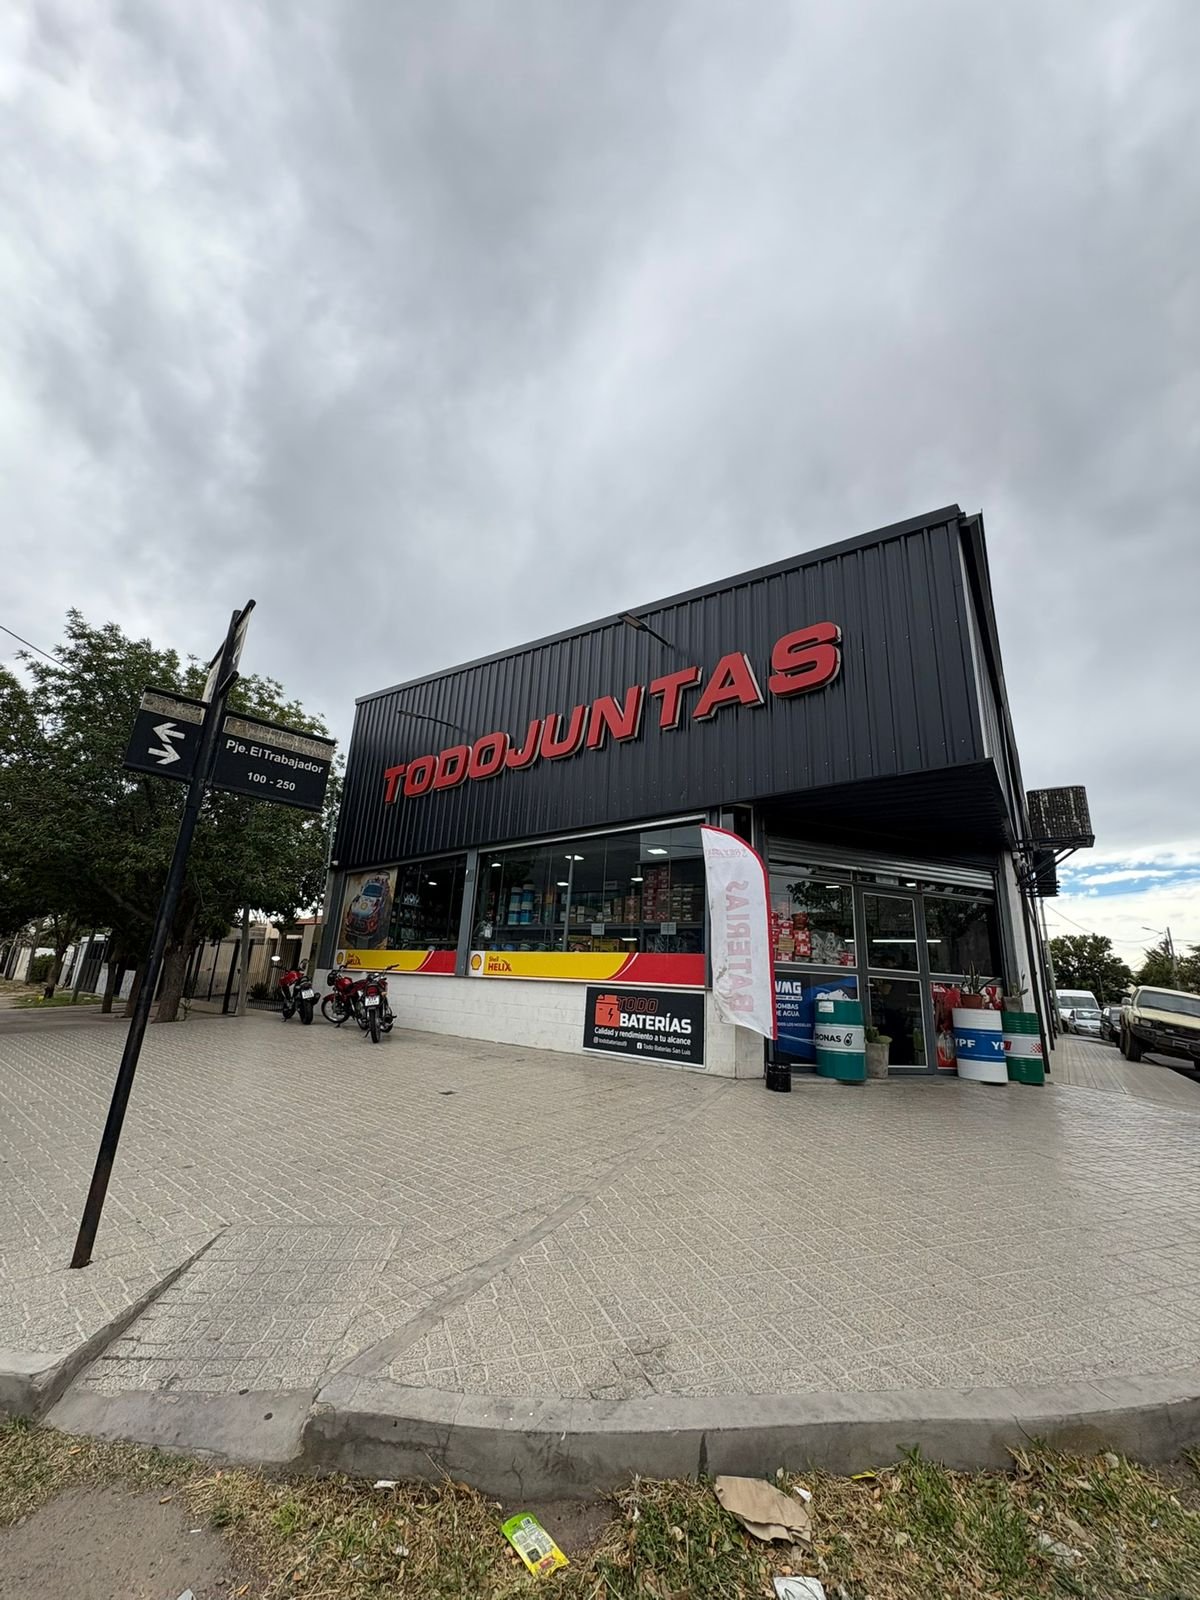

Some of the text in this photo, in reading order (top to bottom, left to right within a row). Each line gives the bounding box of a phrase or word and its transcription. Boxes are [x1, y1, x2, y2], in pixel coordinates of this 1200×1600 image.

[384, 621, 842, 804] TODOJUNTAS
[226, 740, 324, 773] Pje. El Trabajador
[247, 772, 267, 784] 100
[275, 779, 296, 791] 250
[488, 960, 512, 972] HELIX
[618, 995, 659, 1013] TODO
[619, 1013, 692, 1034] BATERÍAS
[594, 1027, 615, 1036] Calidad
[619, 1031, 653, 1041] rendimiento
[667, 1036, 691, 1045] alcance
